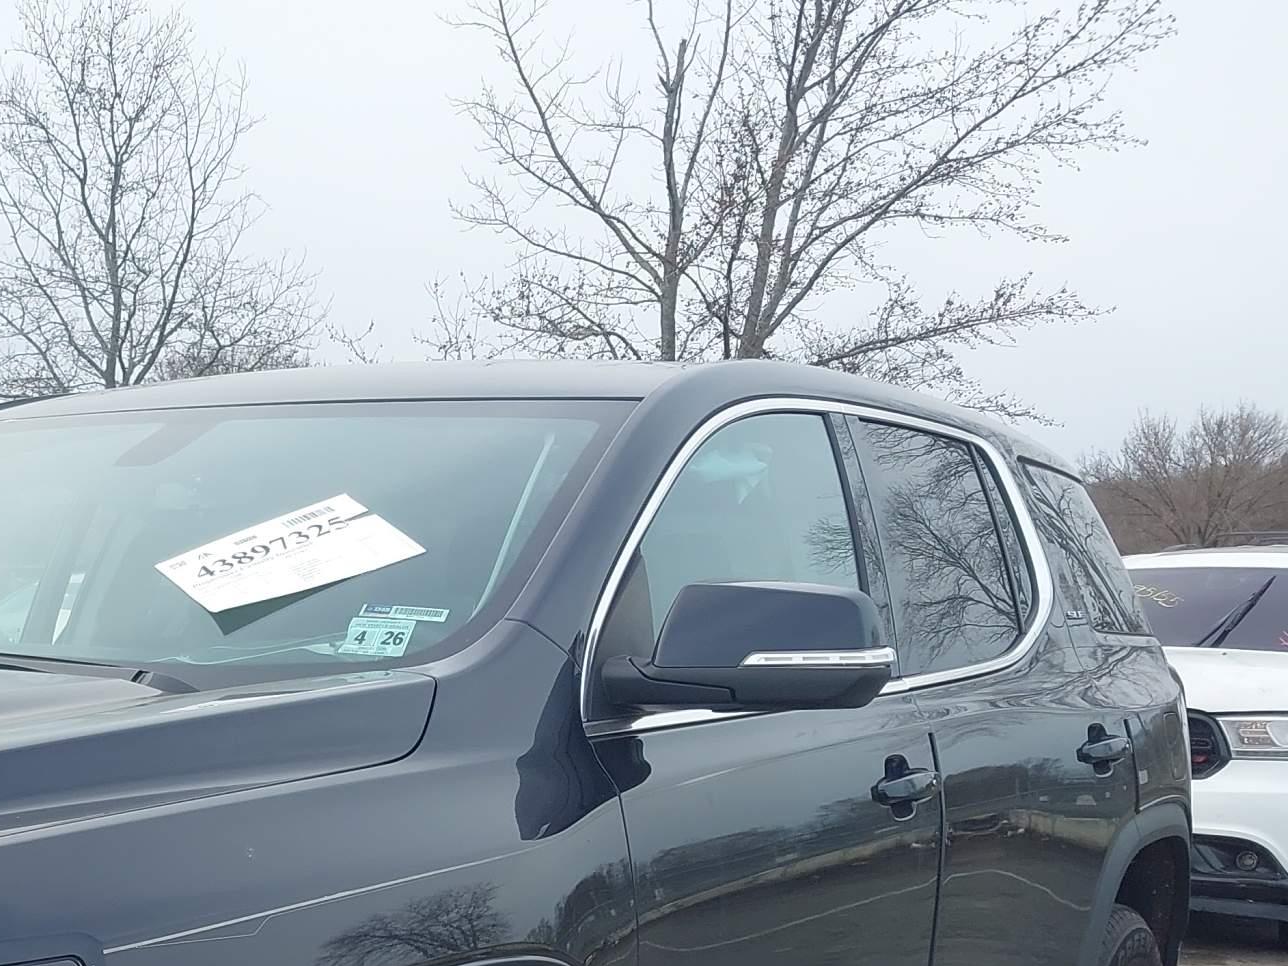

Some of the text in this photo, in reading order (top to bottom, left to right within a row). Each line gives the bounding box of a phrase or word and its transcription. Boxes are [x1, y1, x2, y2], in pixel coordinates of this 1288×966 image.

[197, 516, 349, 579] 43897325
[354, 630, 405, 646] 4 26
